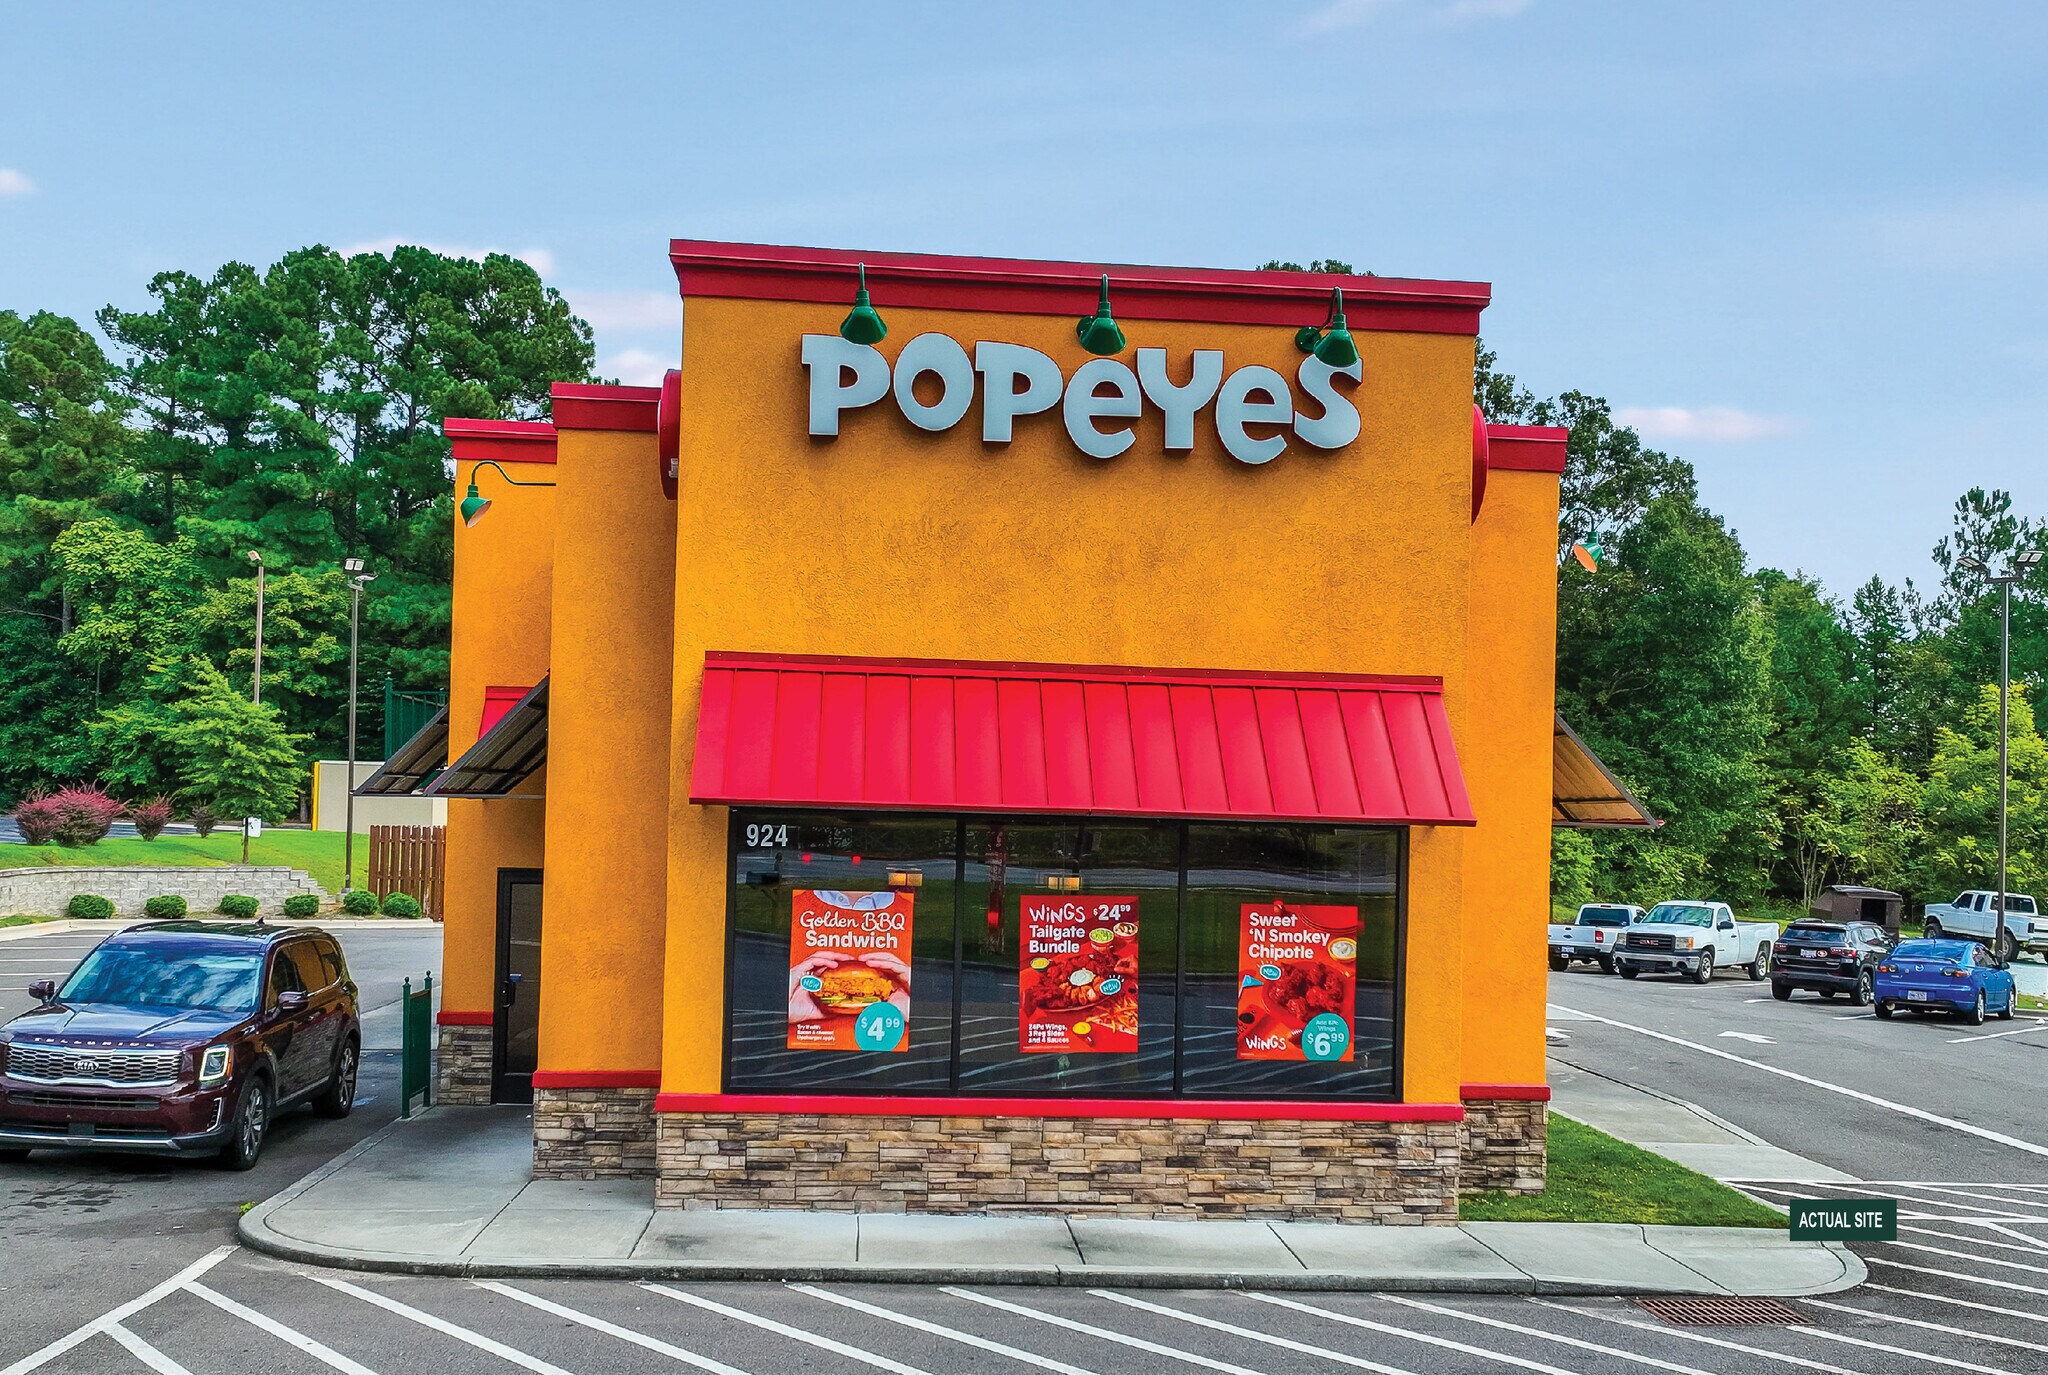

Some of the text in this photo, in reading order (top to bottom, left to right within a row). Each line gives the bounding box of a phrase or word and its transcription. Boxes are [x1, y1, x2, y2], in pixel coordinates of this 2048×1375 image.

[746, 824, 788, 847] 924
[800, 911, 905, 932] Golden BBQ
[1249, 912, 1298, 927] Sweet
[805, 929, 898, 949] Sandwich
[1028, 925, 1085, 941] Tailgate
[1269, 929, 1330, 946] Smokey
[1028, 940, 1080, 953] Bundle
[1248, 944, 1314, 961] Chipotle
[77, 1061, 95, 1071] KIA
